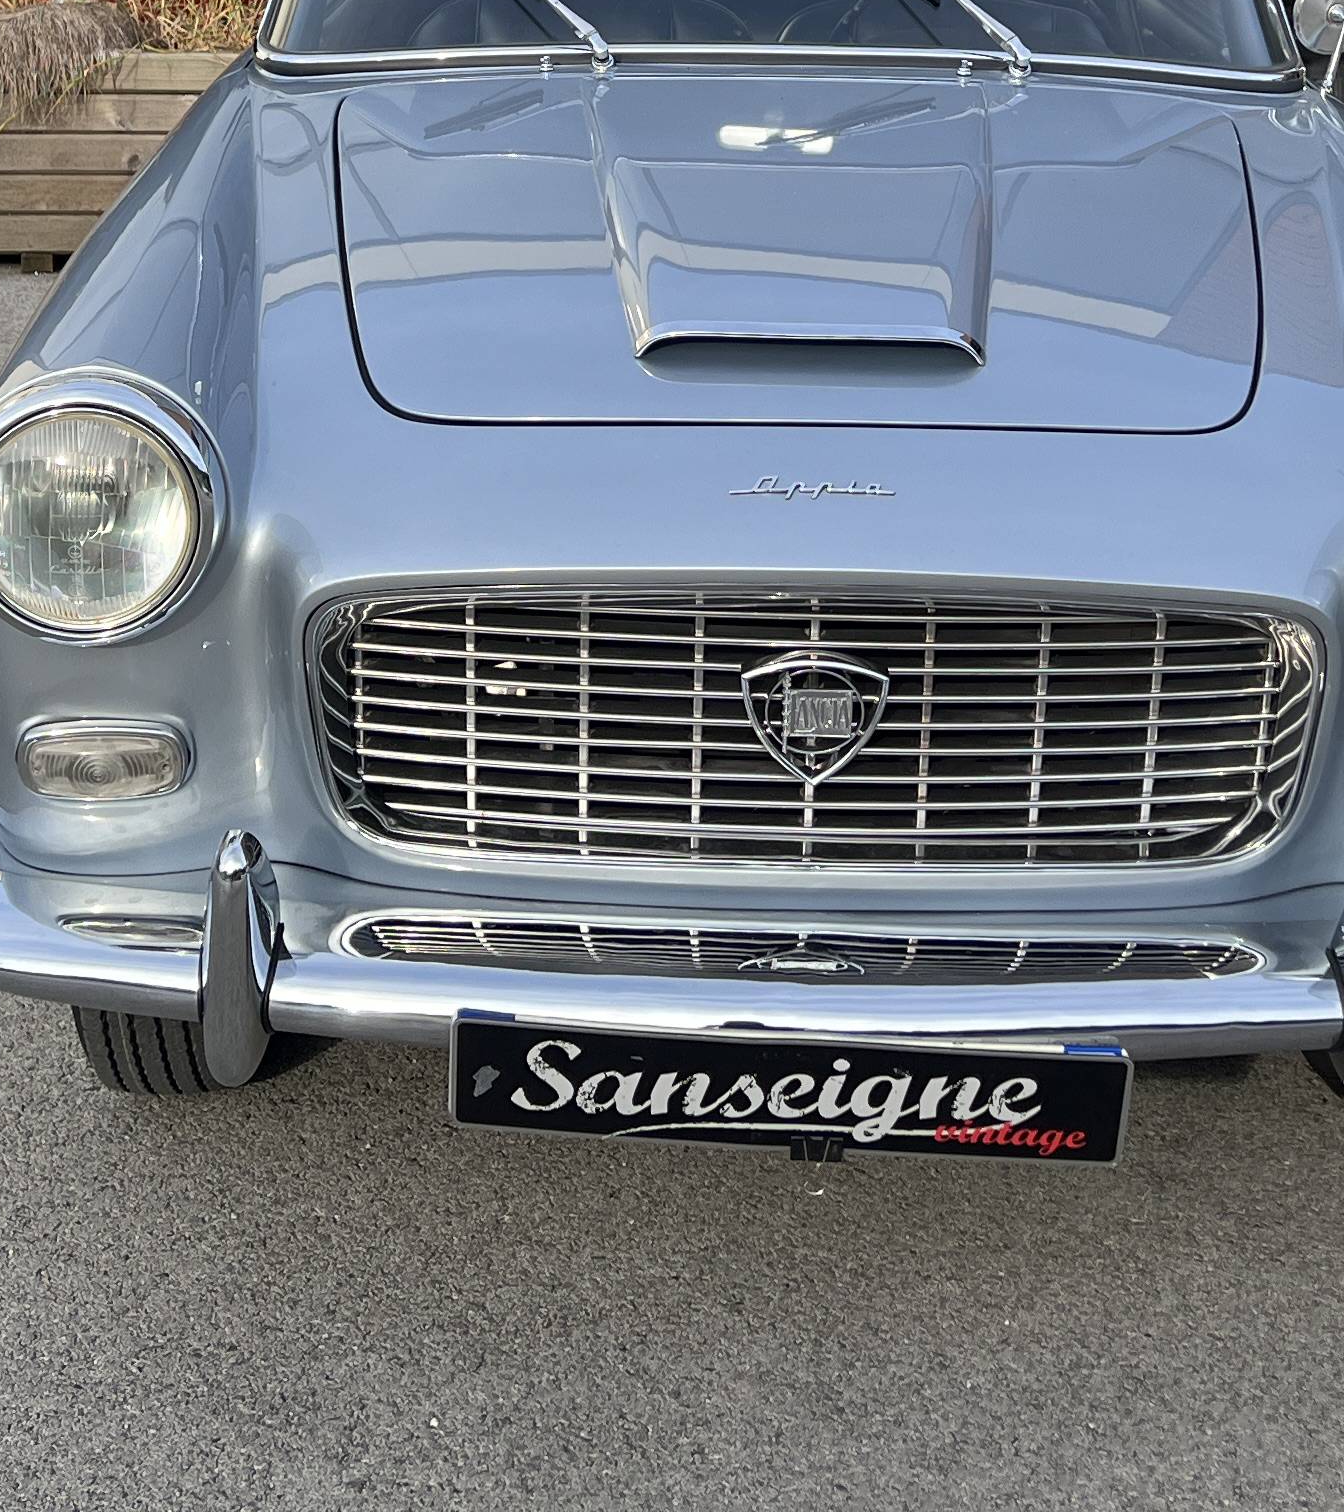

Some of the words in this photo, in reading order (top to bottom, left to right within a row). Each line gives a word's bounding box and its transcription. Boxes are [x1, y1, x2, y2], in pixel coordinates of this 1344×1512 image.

[729, 473, 896, 500] Appia
[511, 1039, 1043, 1143] Sanseigne
[934, 1119, 1088, 1154] vintage
